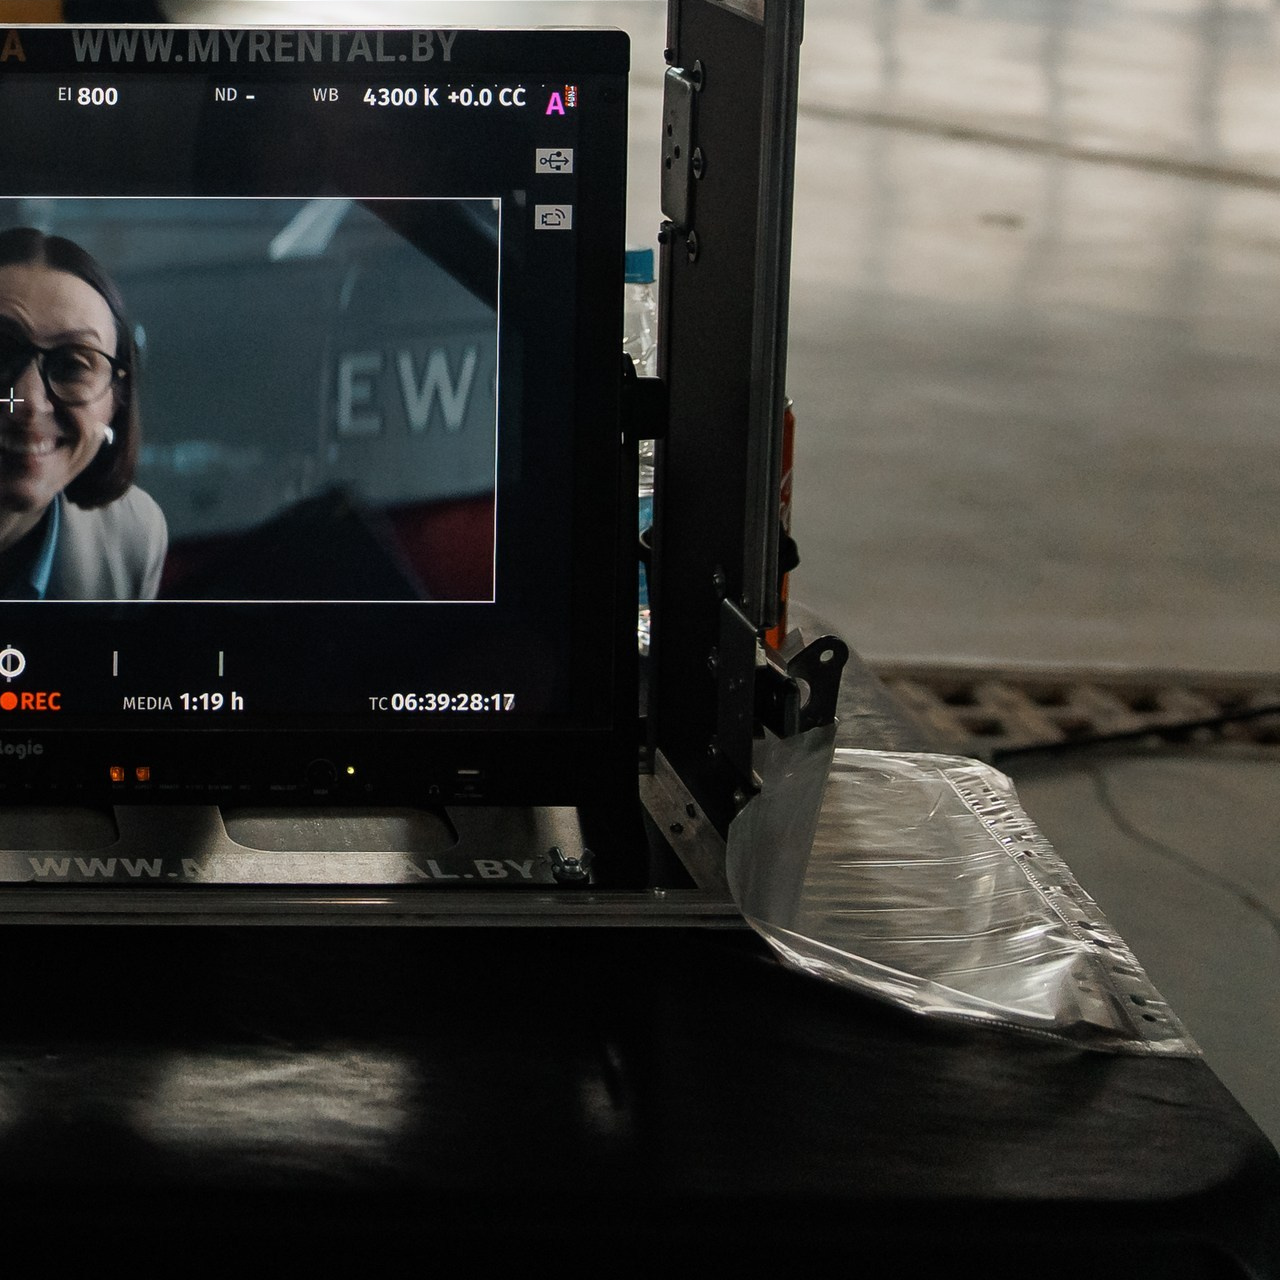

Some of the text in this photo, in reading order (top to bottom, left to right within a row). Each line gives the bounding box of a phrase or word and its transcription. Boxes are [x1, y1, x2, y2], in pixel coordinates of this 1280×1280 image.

[71, 30, 458, 63] WWW.MYRENTAL.BY
[58, 86, 119, 106] EI 800
[215, 87, 238, 102] ND
[312, 87, 526, 107] WB 4300 K +0.0 CC
[545, 91, 565, 116] A
[20, 691, 61, 711] REC
[122, 691, 244, 711] MEDIA 1:19 h
[368, 693, 515, 712] TC 06:39:28:17
